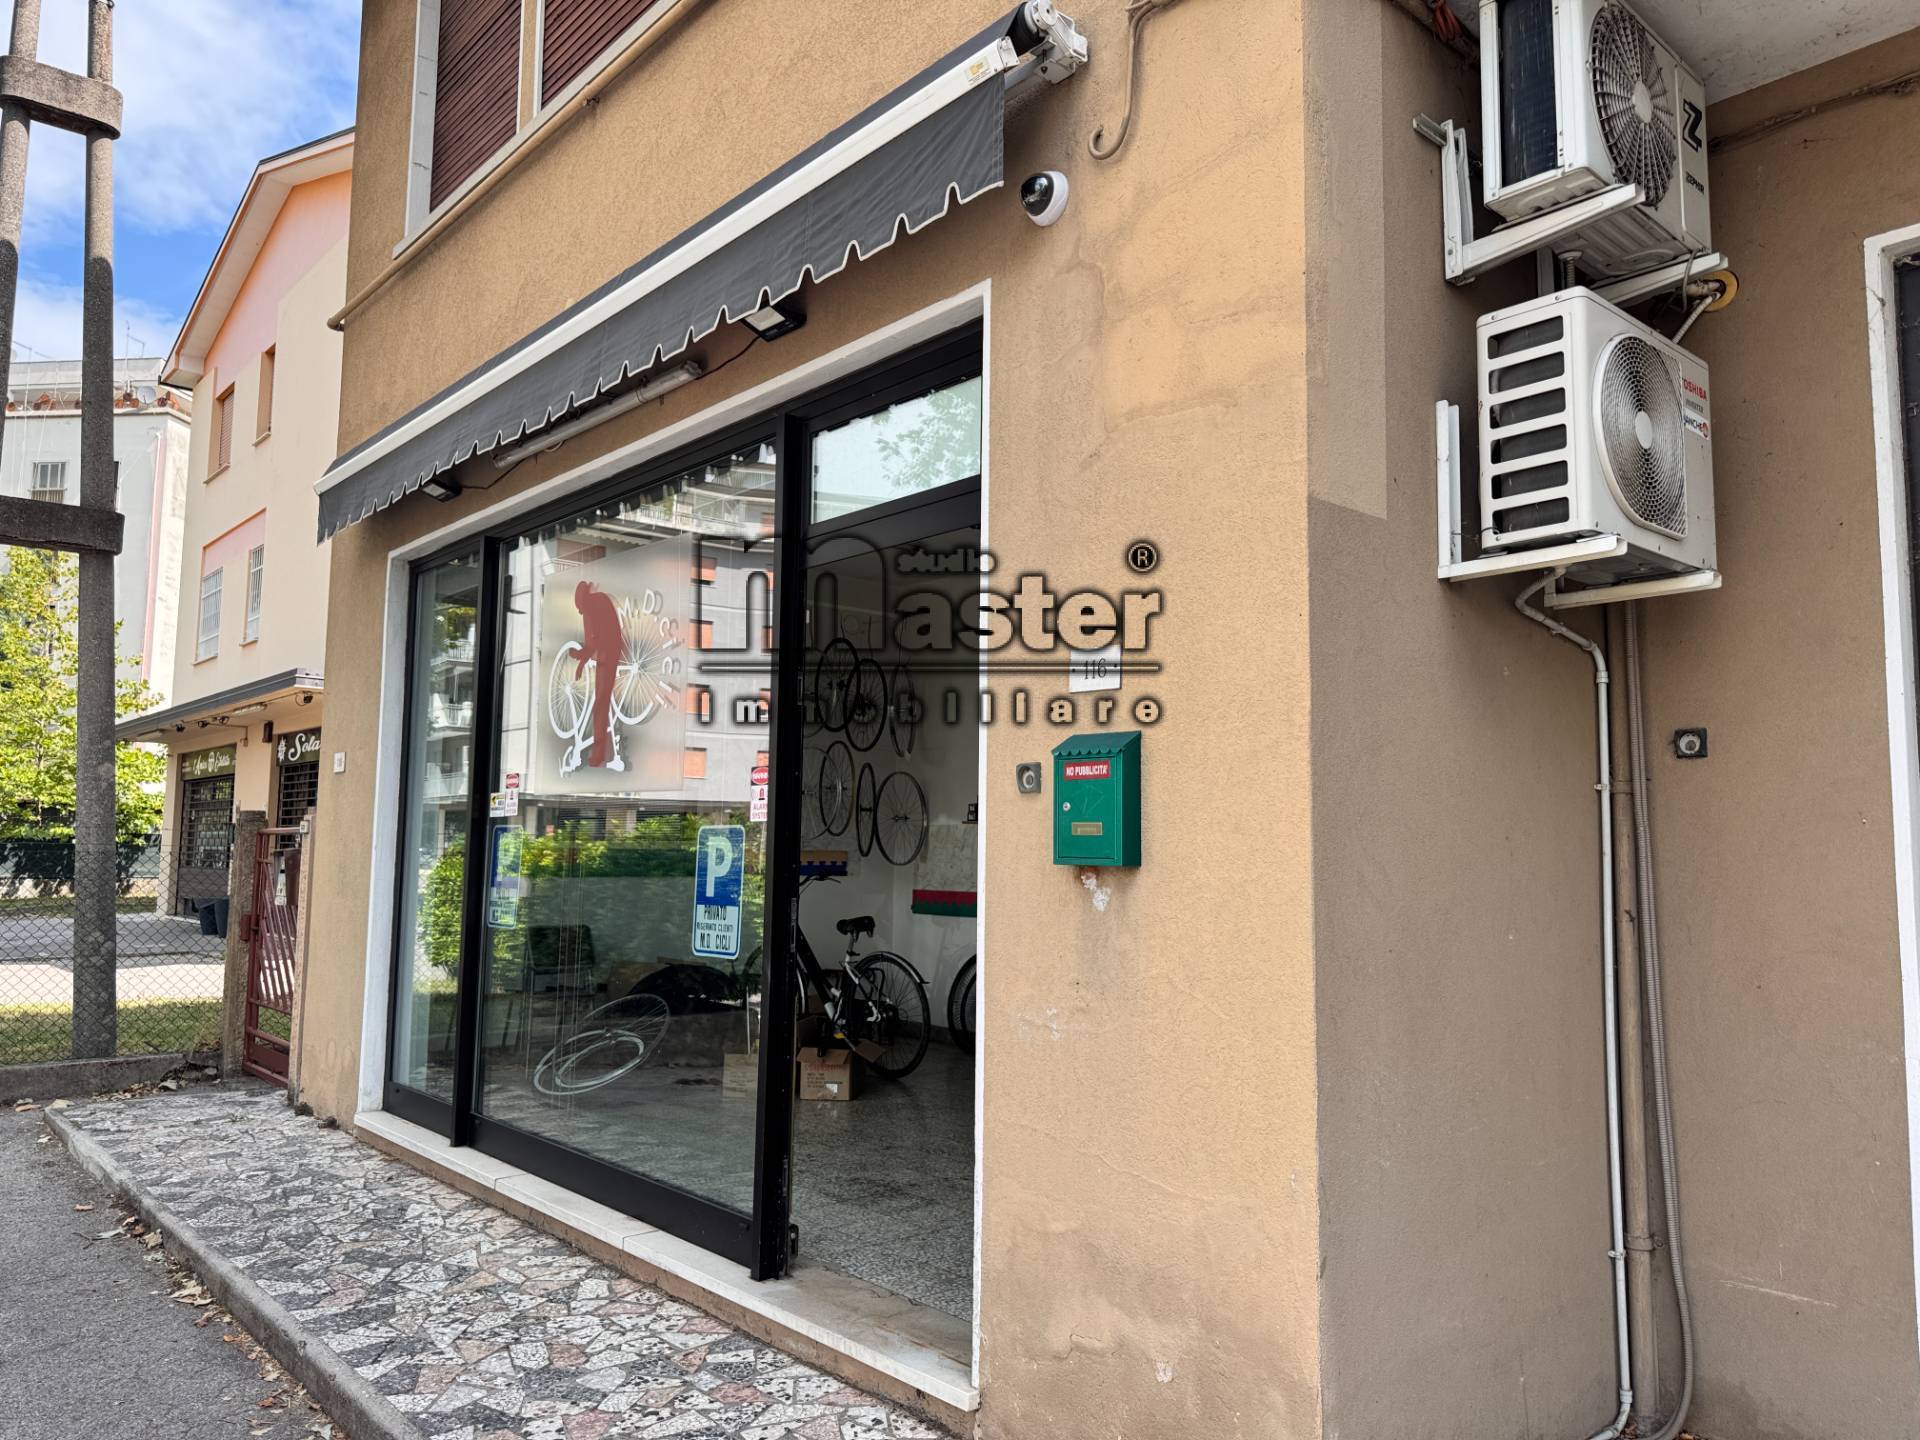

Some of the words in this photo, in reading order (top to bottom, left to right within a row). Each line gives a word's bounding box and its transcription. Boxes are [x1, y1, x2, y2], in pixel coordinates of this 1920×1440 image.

[1081, 657, 1108, 680] 116
[1066, 766, 1075, 776] NO
[705, 836, 733, 897] P
[704, 904, 727, 921] PRIVATO
[715, 933, 731, 951] CICLI
